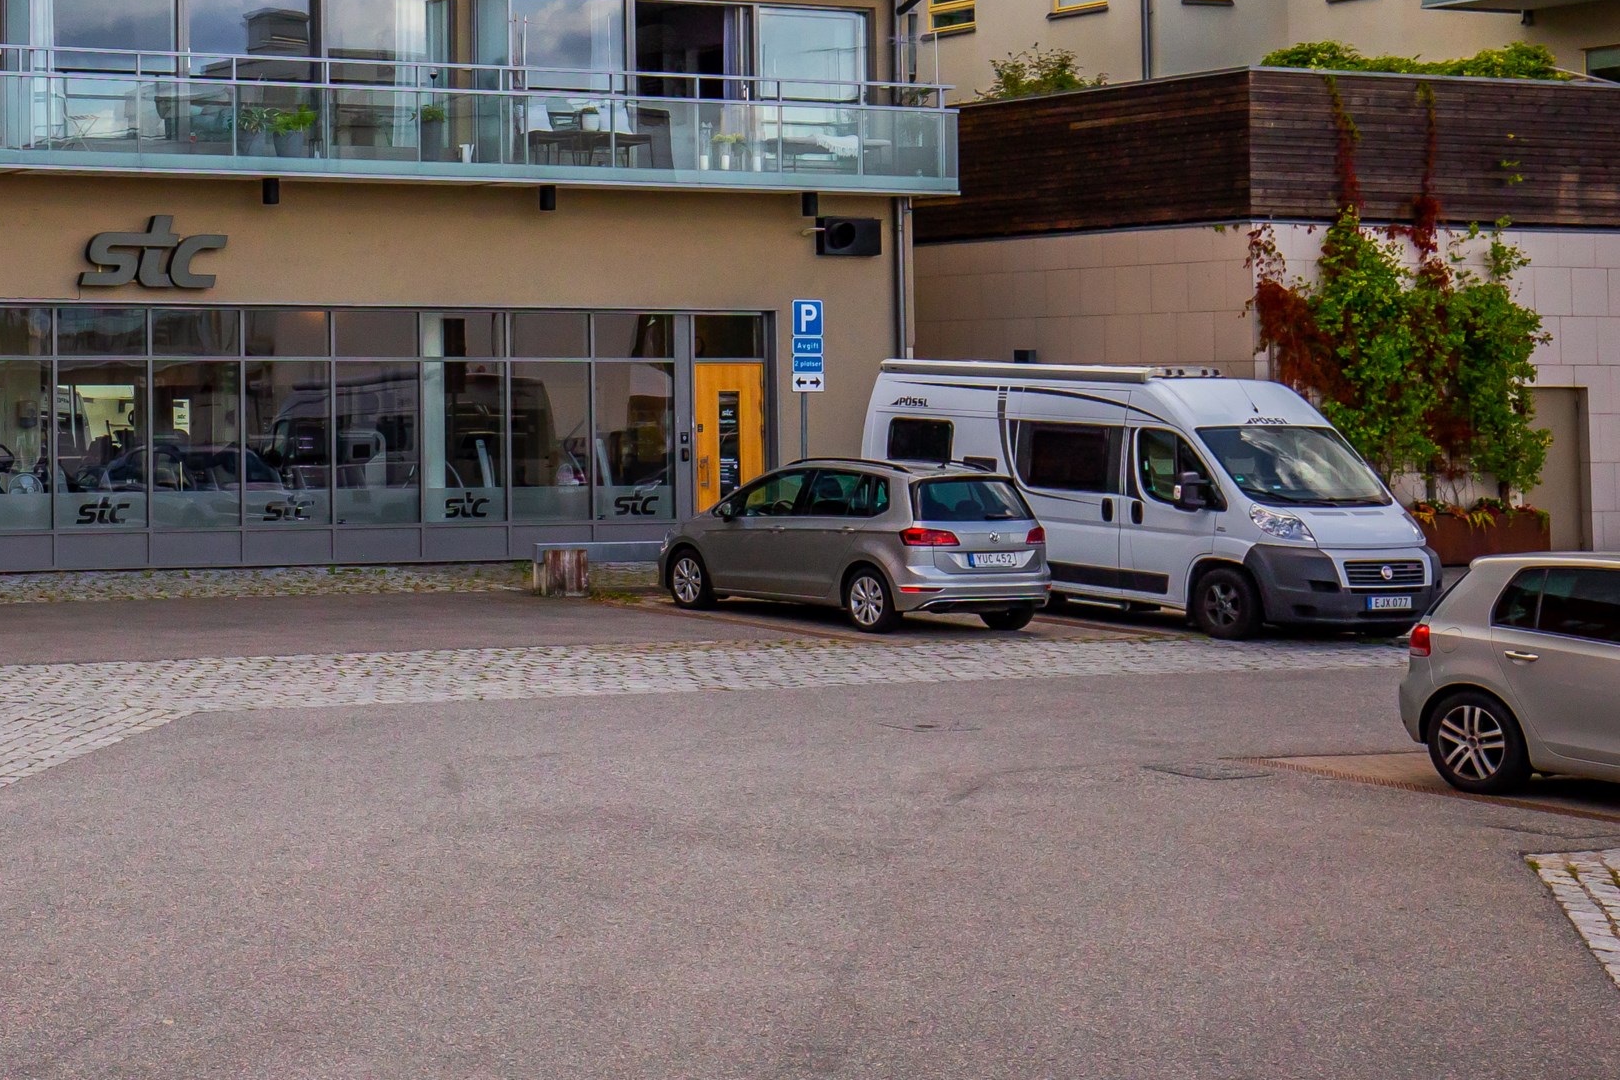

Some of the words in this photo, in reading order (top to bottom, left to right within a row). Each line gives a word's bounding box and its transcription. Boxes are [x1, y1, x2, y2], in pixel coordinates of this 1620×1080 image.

[78, 215, 229, 289] stc
[800, 304, 818, 332] P
[797, 342, 819, 350] Avgift
[899, 396, 929, 407] PÖSSL
[76, 497, 130, 524] stc
[263, 495, 315, 521] stc
[444, 491, 490, 519] stc
[614, 490, 659, 516] stc
[976, 554, 994, 564] YUC
[996, 553, 1012, 563] 452
[1374, 598, 1391, 608] EJX
[1392, 597, 1408, 607] 077
